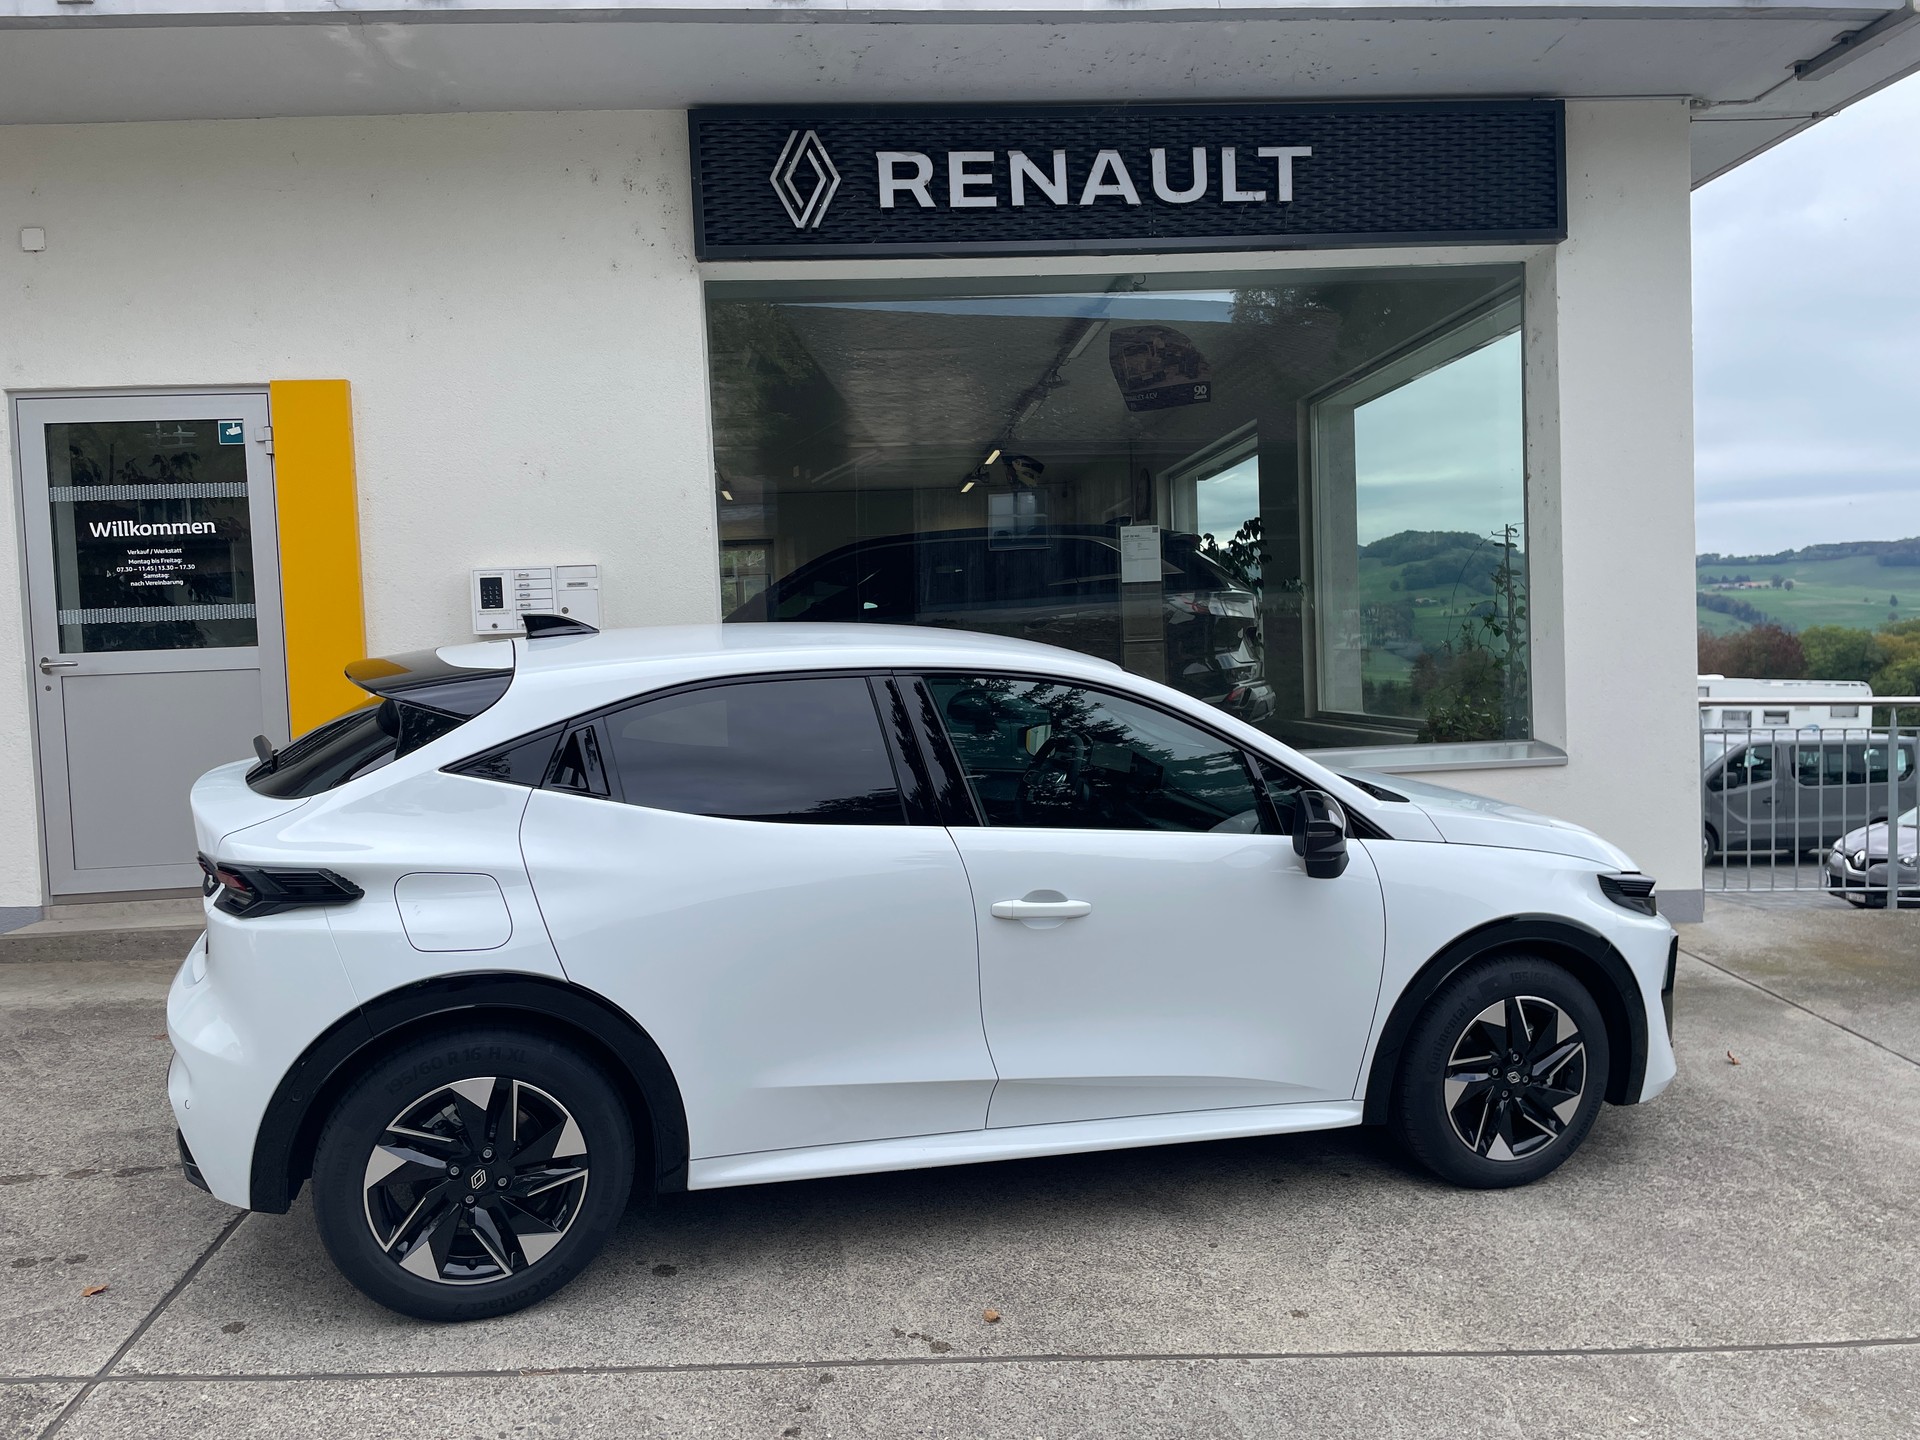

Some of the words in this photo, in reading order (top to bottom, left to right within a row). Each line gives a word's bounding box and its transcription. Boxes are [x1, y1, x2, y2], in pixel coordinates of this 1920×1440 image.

[875, 146, 1313, 209] RENAULT
[89, 520, 217, 538] Willkommen
[145, 579, 184, 587] Vereinbarung
[383, 1056, 444, 1097] 195/60
[447, 1051, 461, 1065] R
[462, 1046, 482, 1063] 16
[489, 1045, 502, 1061] H
[470, 1264, 571, 1314] EcoContact
